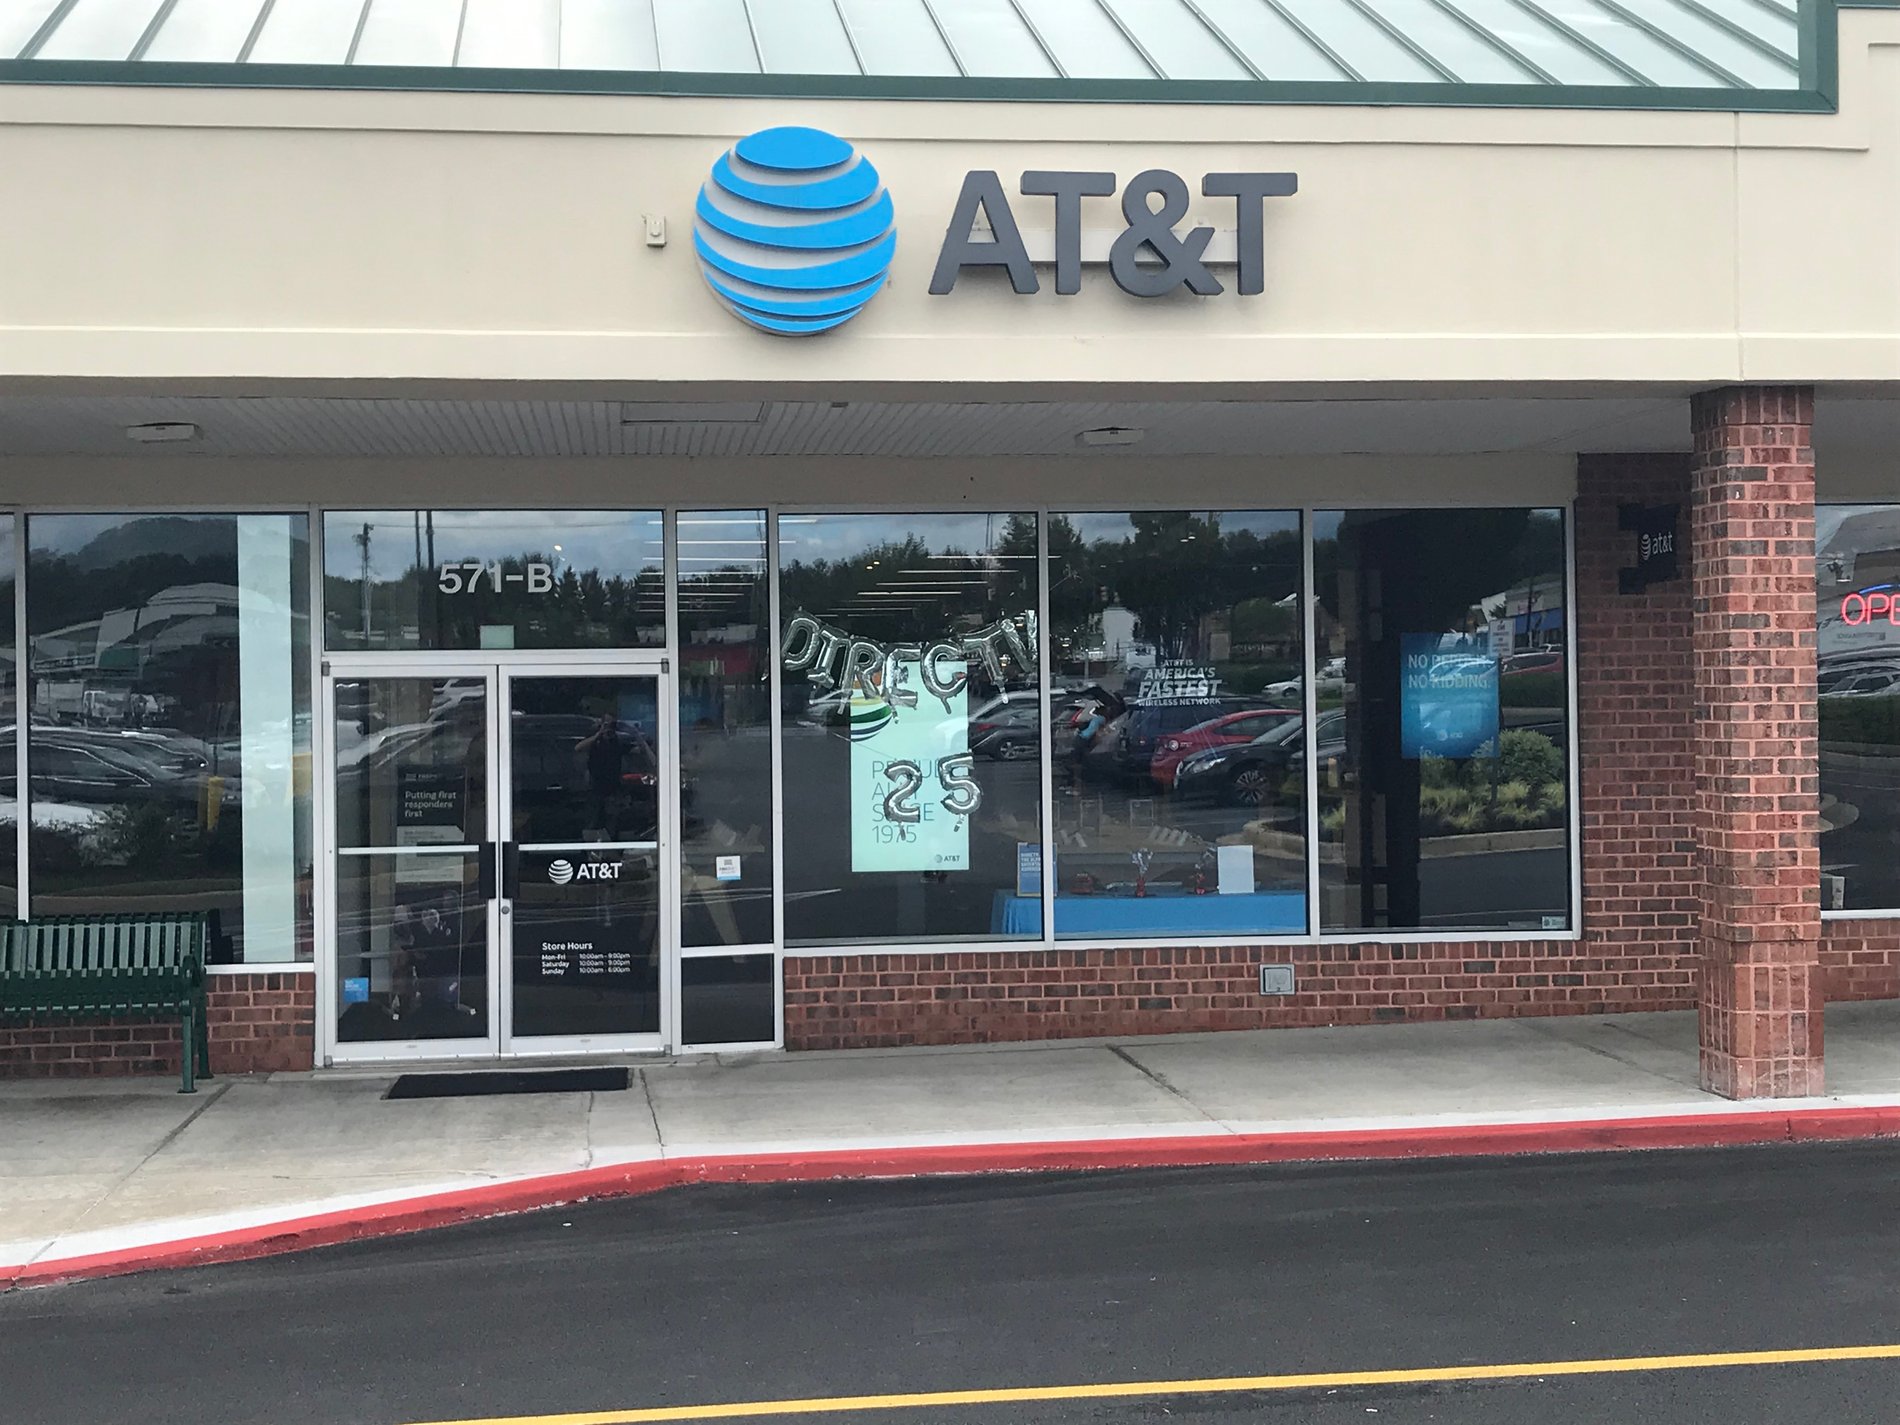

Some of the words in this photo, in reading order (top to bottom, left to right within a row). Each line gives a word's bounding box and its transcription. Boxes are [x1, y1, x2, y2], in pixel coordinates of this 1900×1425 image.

[927, 168, 1299, 297] AT&T
[1652, 531, 1673, 555] at&t
[438, 563, 553, 594] 571-B
[781, 609, 1038, 712] DIRECTV
[1408, 654, 1428, 669] NO
[1144, 667, 1216, 680] AMERICA'S
[1138, 680, 1223, 698] FASTEST
[1408, 674, 1428, 689] NO
[1138, 698, 1178, 706] WIRELESS
[1180, 697, 1221, 706] NETWORK
[405, 791, 437, 800] Putting
[438, 790, 457, 799] first
[884, 752, 982, 823] 25
[405, 800, 453, 809] responders
[576, 862, 623, 880] AT&T
[542, 942, 566, 951] Store
[567, 942, 593, 950] Hours
[542, 968, 565, 976] Sunday
